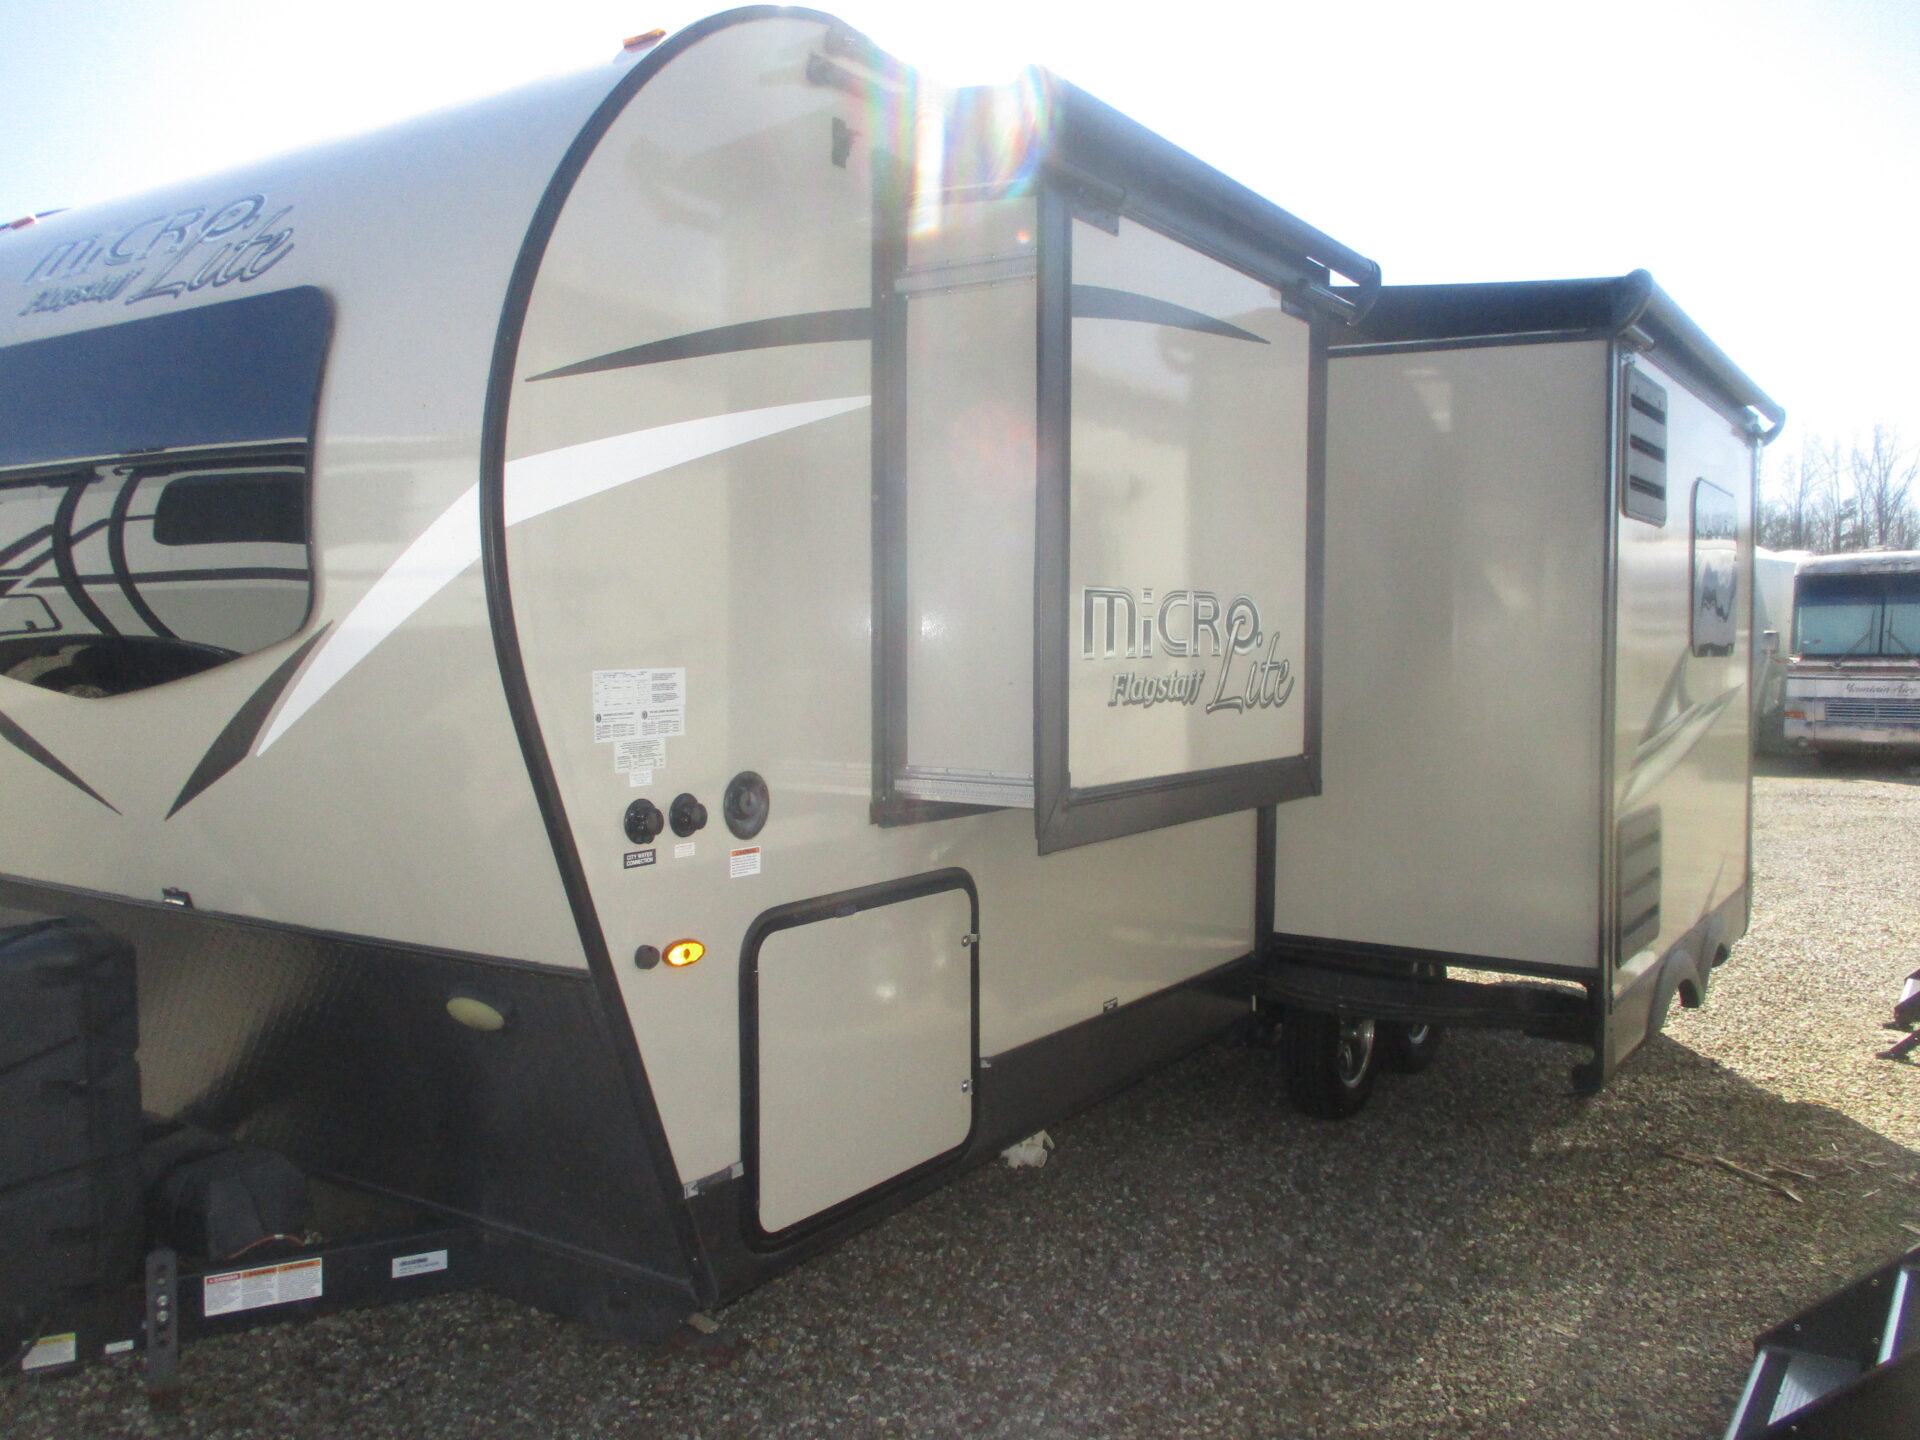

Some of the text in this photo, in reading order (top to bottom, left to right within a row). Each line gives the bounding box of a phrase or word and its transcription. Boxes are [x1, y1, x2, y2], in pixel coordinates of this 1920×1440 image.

[124, 205, 295, 306] Lite
[1107, 615, 1295, 715] Flagstaff Lite
[626, 857, 654, 867] CONNECTION
